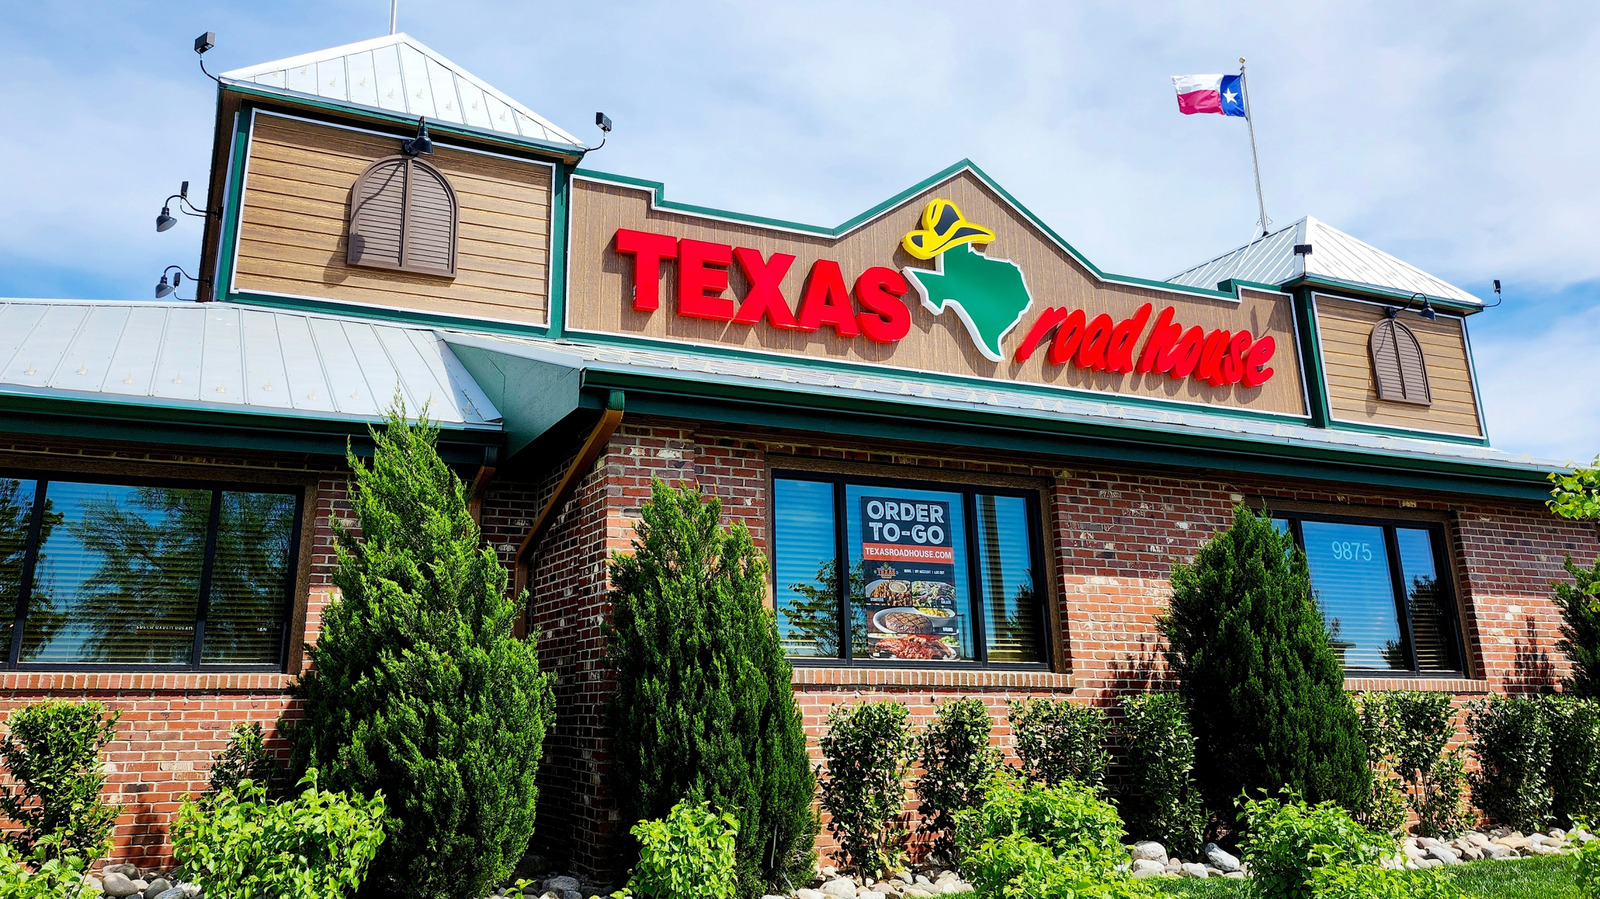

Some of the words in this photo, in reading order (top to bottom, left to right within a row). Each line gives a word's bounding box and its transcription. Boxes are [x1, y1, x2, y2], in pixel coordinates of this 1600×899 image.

[615, 228, 911, 343] TEXAS
[866, 500, 945, 523] ORDER
[868, 522, 945, 545] TO-GO
[865, 547, 952, 559] TEXASROADHOUSE.COM
[1332, 541, 1372, 561] 9875
